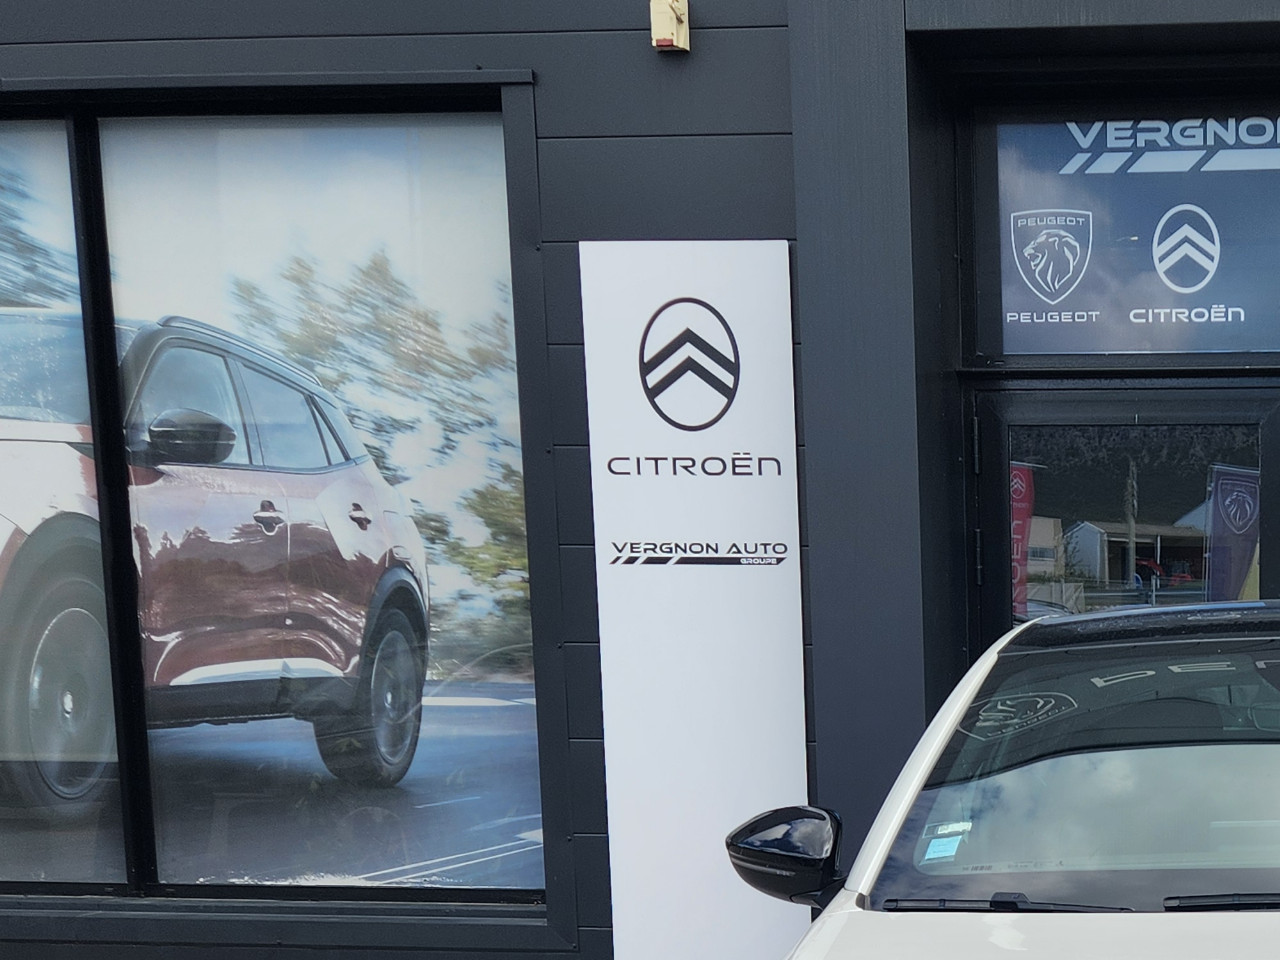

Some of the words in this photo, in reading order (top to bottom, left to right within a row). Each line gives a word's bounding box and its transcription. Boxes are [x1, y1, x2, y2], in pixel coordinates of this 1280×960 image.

[1017, 216, 1086, 228] PEUGEOT
[1006, 311, 1101, 323] PEUGEOT
[611, 542, 719, 555] VERGNON
[726, 542, 788, 554] AUTO
